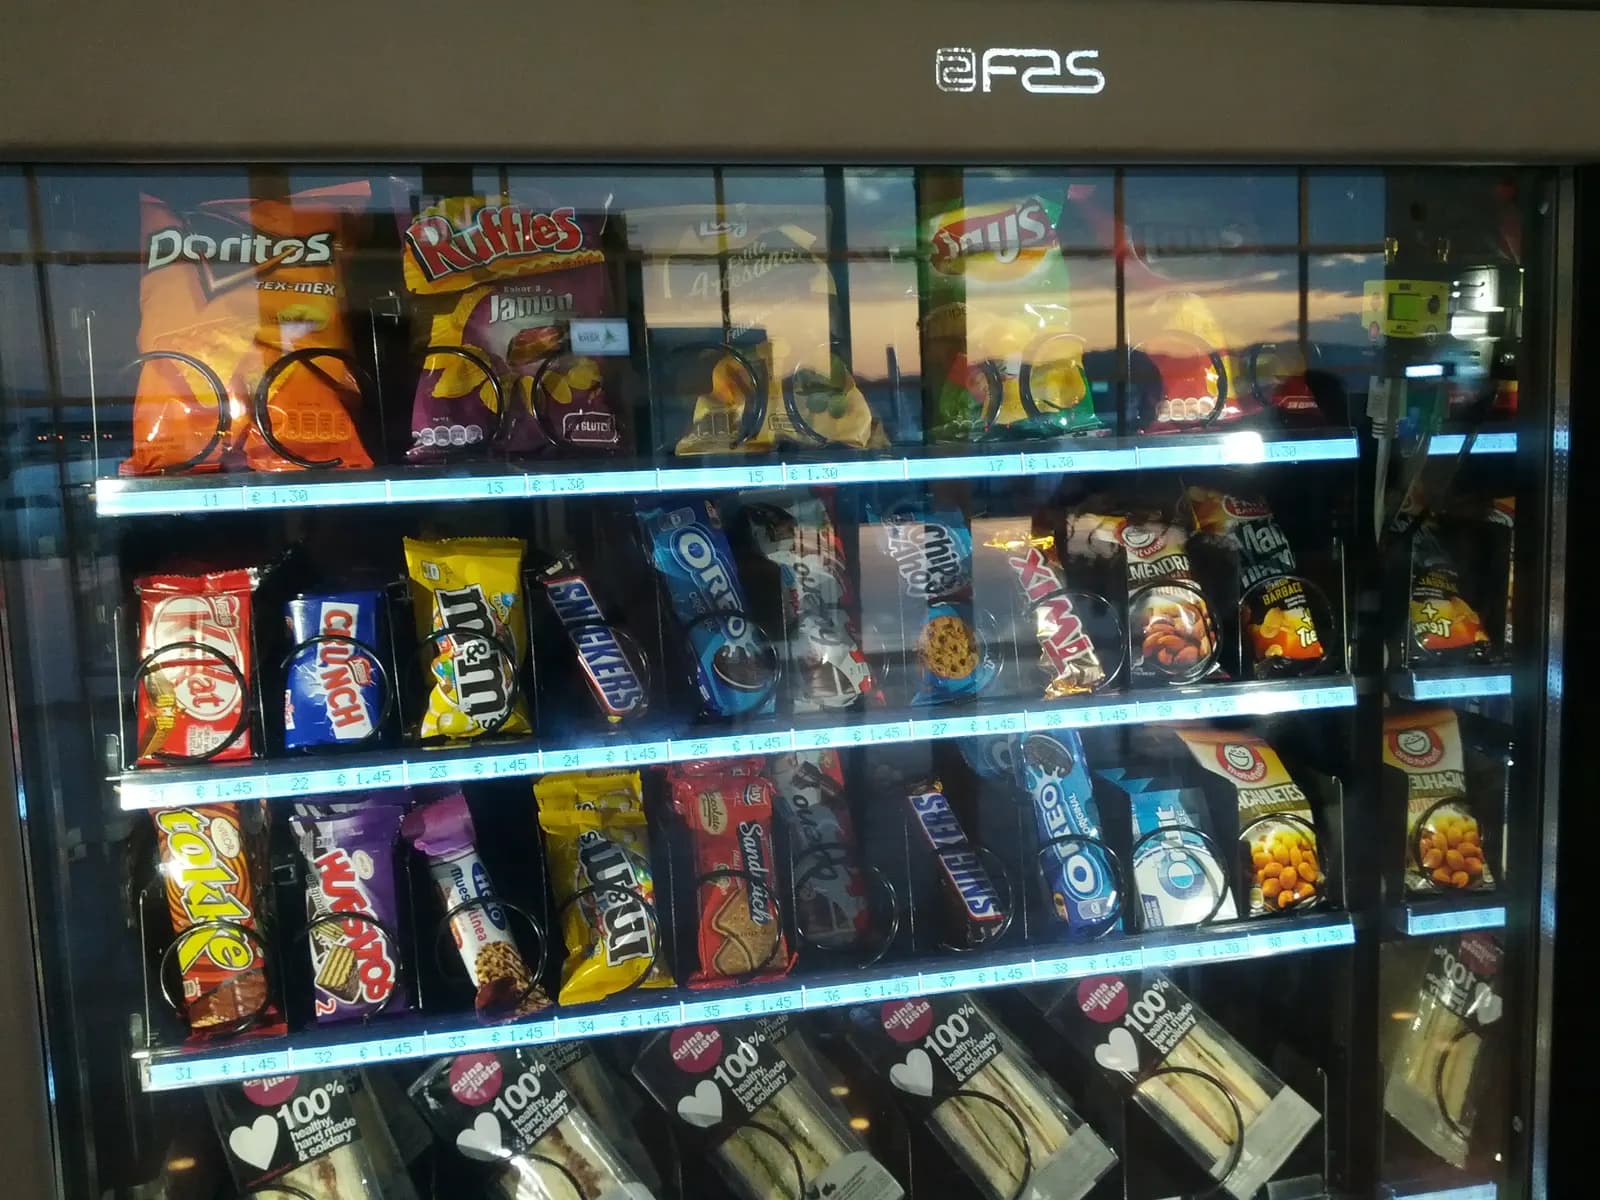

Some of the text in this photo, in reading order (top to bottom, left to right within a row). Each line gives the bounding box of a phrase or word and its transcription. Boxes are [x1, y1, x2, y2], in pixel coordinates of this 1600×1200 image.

[407, 206, 586, 283] Ruffles
[748, 470, 764, 484] 15
[807, 466, 838, 480] 1.30
[1044, 455, 1074, 470] 1.30
[271, 490, 308, 504] 1.30
[487, 481, 504, 494] 13
[551, 477, 585, 492] 1.30
[678, 531, 746, 639] OREO
[1008, 548, 1094, 679] TWIX
[547, 580, 644, 711] SNICKERS
[319, 609, 366, 729] CRUNCH
[931, 722, 947, 736] 27
[983, 716, 1015, 731] 1.45
[1099, 709, 1128, 722] 1.45
[691, 743, 709, 757] 25
[750, 736, 781, 750] 1.45
[814, 732, 831, 746] 26
[871, 726, 900, 740] 1.45
[429, 765, 448, 779] 23
[493, 758, 527, 774] 1.45
[564, 753, 580, 767] 24
[624, 746, 657, 761] 1.45
[216, 781, 252, 797] 1.45
[291, 777, 309, 791] 22
[356, 770, 392, 785] 1.45
[1040, 783, 1096, 895] OREO
[314, 850, 395, 1001] HUESITOS
[1104, 954, 1134, 969] 1.45
[824, 989, 840, 1003] 36
[880, 981, 909, 996] 1.45
[939, 975, 956, 989] 37
[991, 967, 1023, 983] 1.45
[316, 997, 337, 1017] 2
[704, 1005, 721, 1018] 35
[760, 996, 792, 1011] 1.45
[1099, 980, 1125, 1010] justa
[1124, 978, 1169, 1033] 100%
[578, 1020, 595, 1034] 34
[638, 1011, 671, 1026] 1.45
[903, 1000, 931, 1030] justa
[924, 1003, 976, 1057] 100%
[1151, 1002, 1193, 1048] hand made
[449, 1035, 466, 1049] 33
[510, 1026, 543, 1041] 1.45
[692, 1029, 721, 1061] justa
[1159, 1014, 1197, 1054] & solidary
[176, 1066, 193, 1080] 31
[241, 1057, 276, 1073] 1.45
[315, 1050, 332, 1064] 32
[379, 1042, 413, 1058] 1.45
[714, 1031, 766, 1088] 100%
[949, 1031, 996, 1075] hand made
[955, 1043, 998, 1083] & solidary
[471, 1060, 501, 1092] justa
[493, 1060, 546, 1120] 100%
[738, 1058, 787, 1105] hand made
[277, 1079, 345, 1130] 100%
[745, 1072, 788, 1113] & solidary
[517, 1088, 568, 1137] hand made
[525, 1102, 569, 1146] & solidary
[295, 1116, 357, 1153] hand made
[298, 1129, 352, 1162] & solidary
